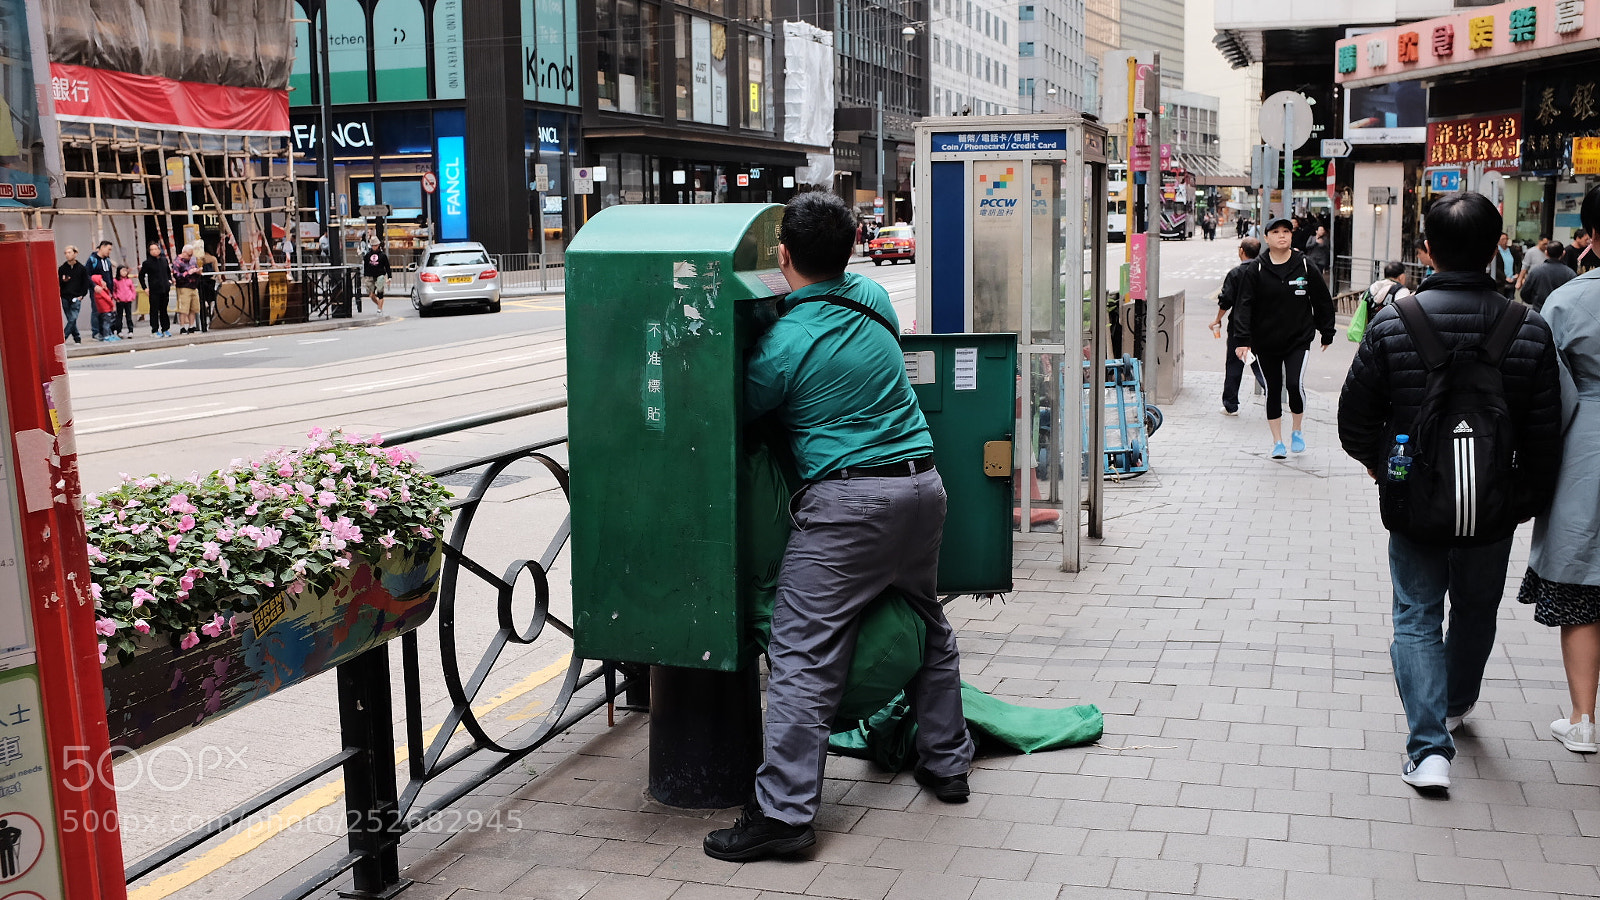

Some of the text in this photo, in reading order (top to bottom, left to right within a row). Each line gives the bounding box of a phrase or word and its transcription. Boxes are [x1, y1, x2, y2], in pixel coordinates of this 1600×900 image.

[446, 14, 457, 31] KIND
[447, 34, 457, 43] TO
[447, 47, 458, 68] EVERY
[696, 61, 707, 72] JUST
[525, 46, 574, 92] Kind
[51, 76, 90, 103] 銀行
[448, 73, 459, 89] KIND
[1037, 142, 1057, 150] Card
[446, 157, 461, 215] FANCL
[979, 198, 1018, 208] PCCW
[647, 322, 662, 421] 不准標貼
[255, 594, 282, 625] SIREN
[258, 603, 283, 631] EDGE
[18, 765, 43, 777] needs
